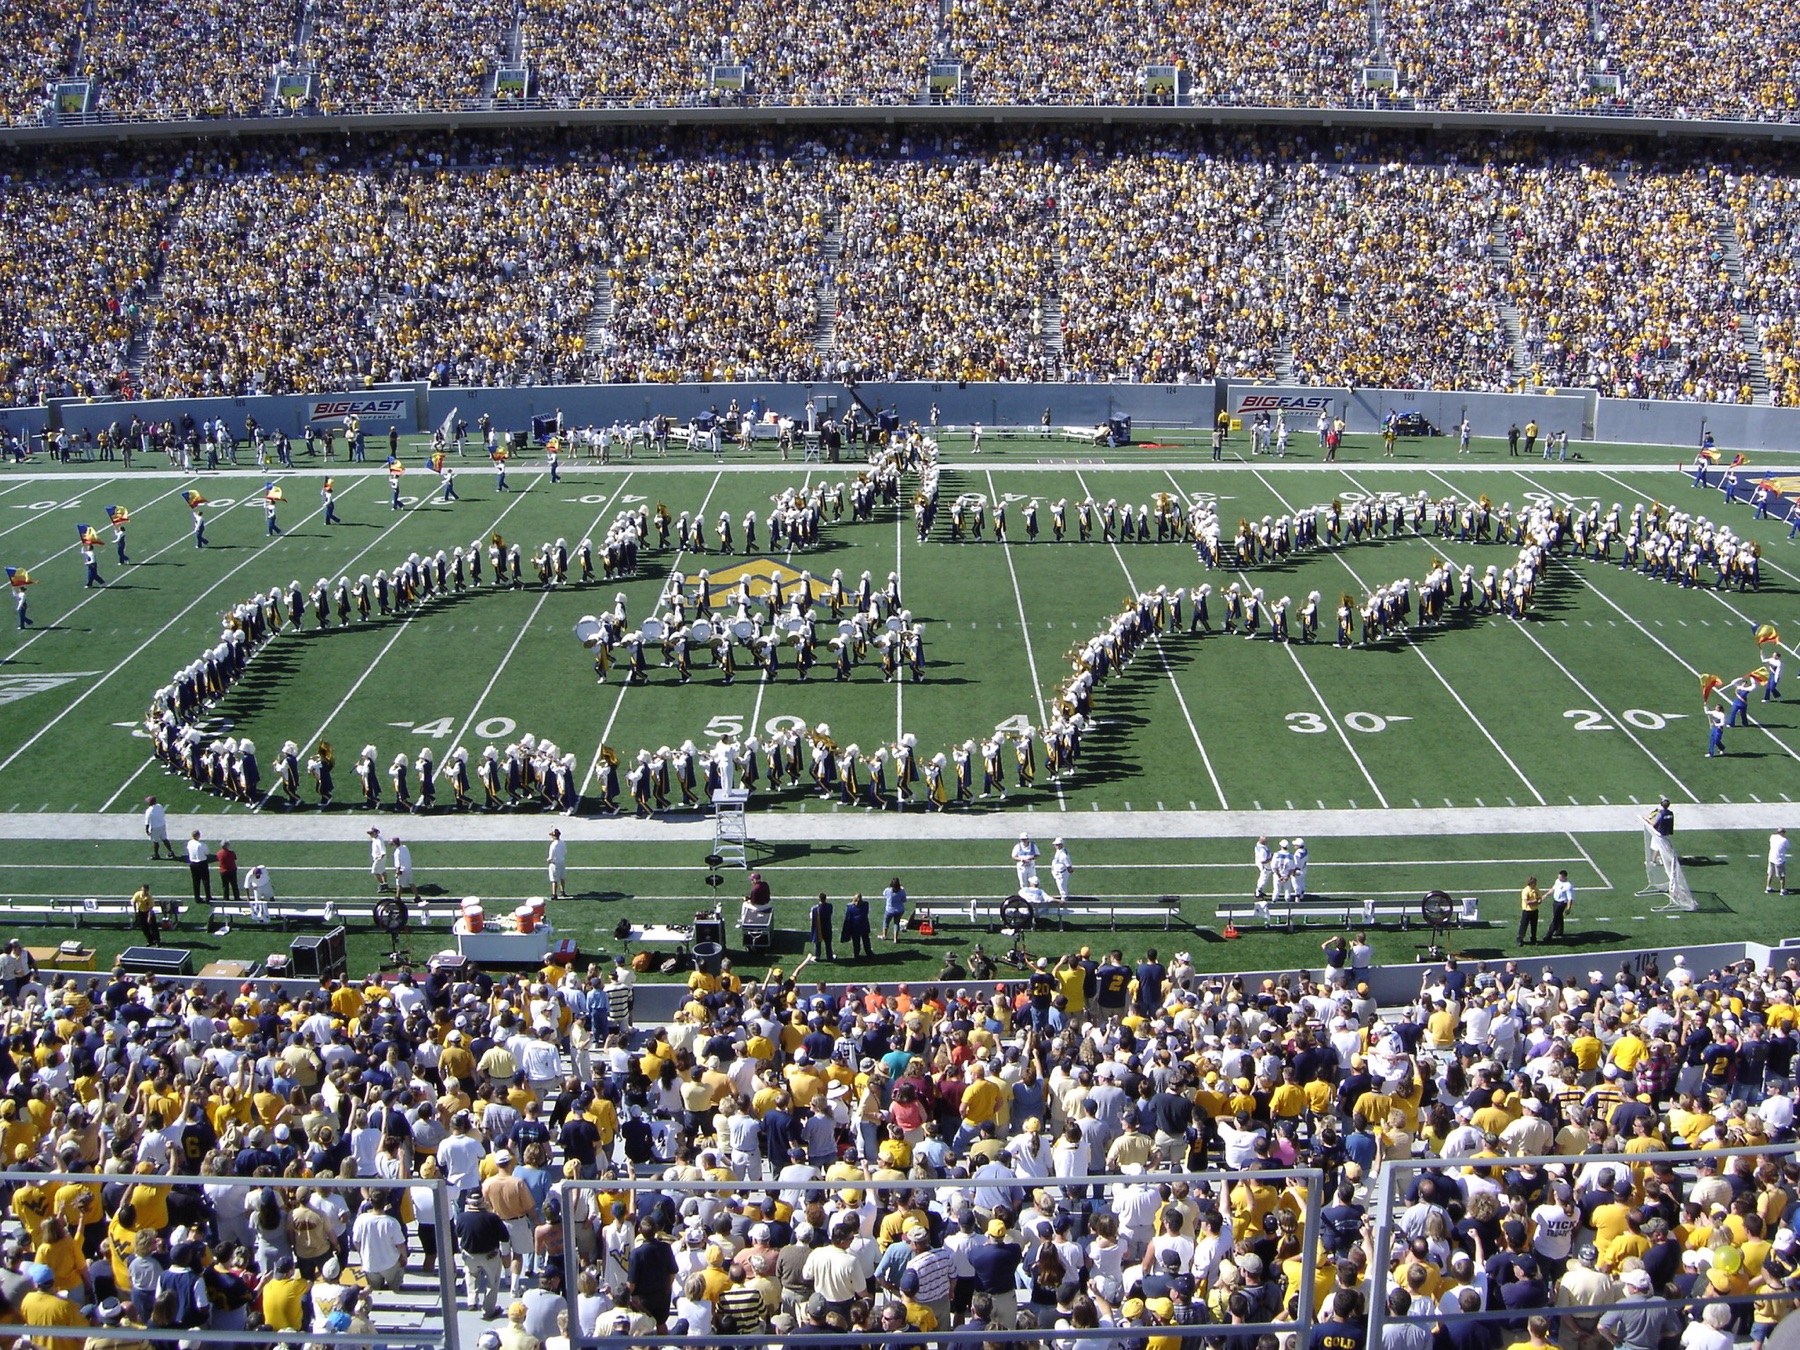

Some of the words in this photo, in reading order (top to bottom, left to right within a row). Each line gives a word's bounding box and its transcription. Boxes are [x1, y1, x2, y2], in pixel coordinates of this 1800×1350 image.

[411, 707, 517, 738] 40
[703, 715, 807, 737] 50
[1284, 712, 1386, 733] 30
[1563, 709, 1666, 730] 20
[1108, 975, 1124, 991] 2
[1711, 1057, 1728, 1075] 2
[1323, 1336, 1356, 1349] GOLD
